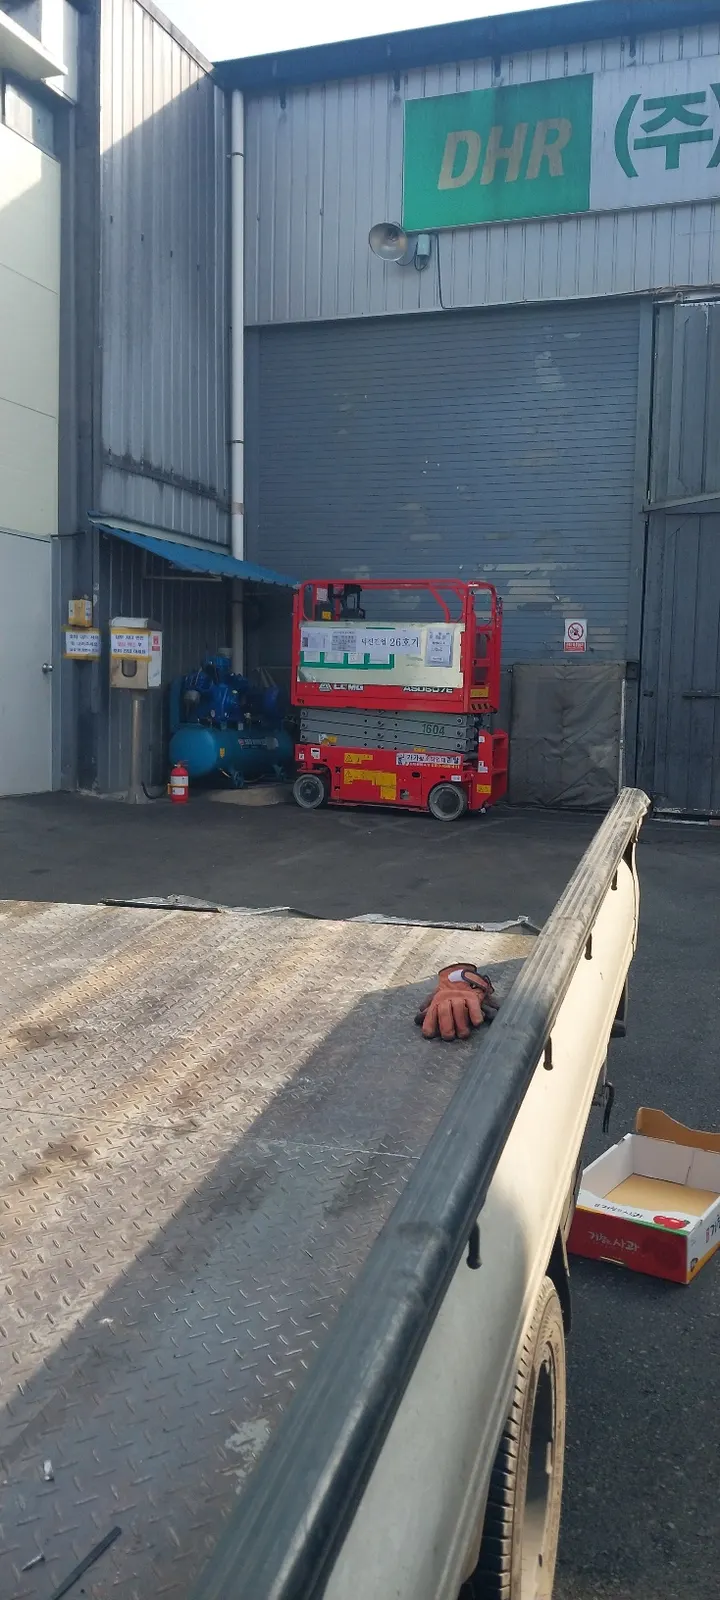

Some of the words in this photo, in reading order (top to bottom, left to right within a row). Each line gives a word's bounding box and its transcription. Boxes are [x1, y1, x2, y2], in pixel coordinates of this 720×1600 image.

[437, 117, 572, 190] DHR
[389, 636, 419, 648] 26호기
[422, 723, 445, 735] 1604
